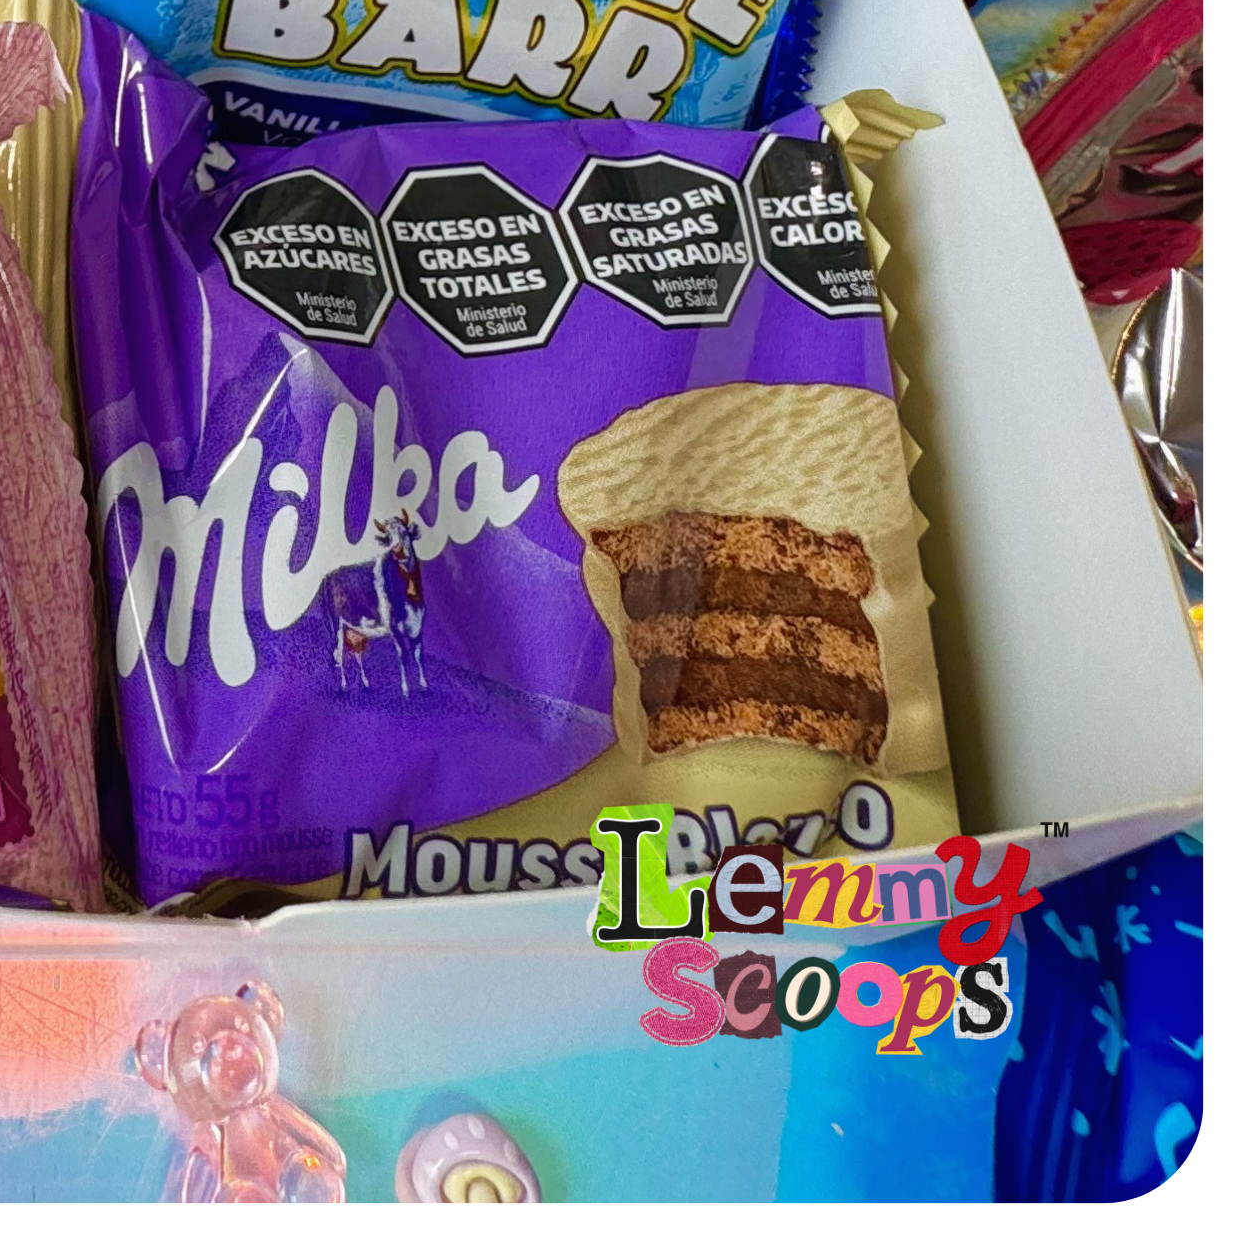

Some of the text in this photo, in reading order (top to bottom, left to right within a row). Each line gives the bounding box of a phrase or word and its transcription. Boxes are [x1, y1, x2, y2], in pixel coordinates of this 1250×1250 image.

[577, 184, 726, 225] EXCESO EN
[230, 224, 372, 250] EXCESO EN
[392, 213, 542, 243] EXCESO EN
[609, 213, 720, 248] GRASAS
[244, 244, 377, 278] AZÚCARES
[418, 242, 532, 271] GRASAS
[592, 241, 749, 279] SATURADAS
[419, 268, 547, 300] TOTALES
[651, 275, 718, 294] Ministerio
[829, 284, 846, 300] de
[295, 291, 358, 313] Ministerio
[456, 303, 527, 323] Ministerio
[664, 290, 718, 309] de Salud
[306, 308, 358, 328] de Salud
[466, 318, 528, 338] de Salud
[97, 385, 540, 687] Milka
[196, 772, 253, 828] 55
[350, 818, 603, 899] Mouss
